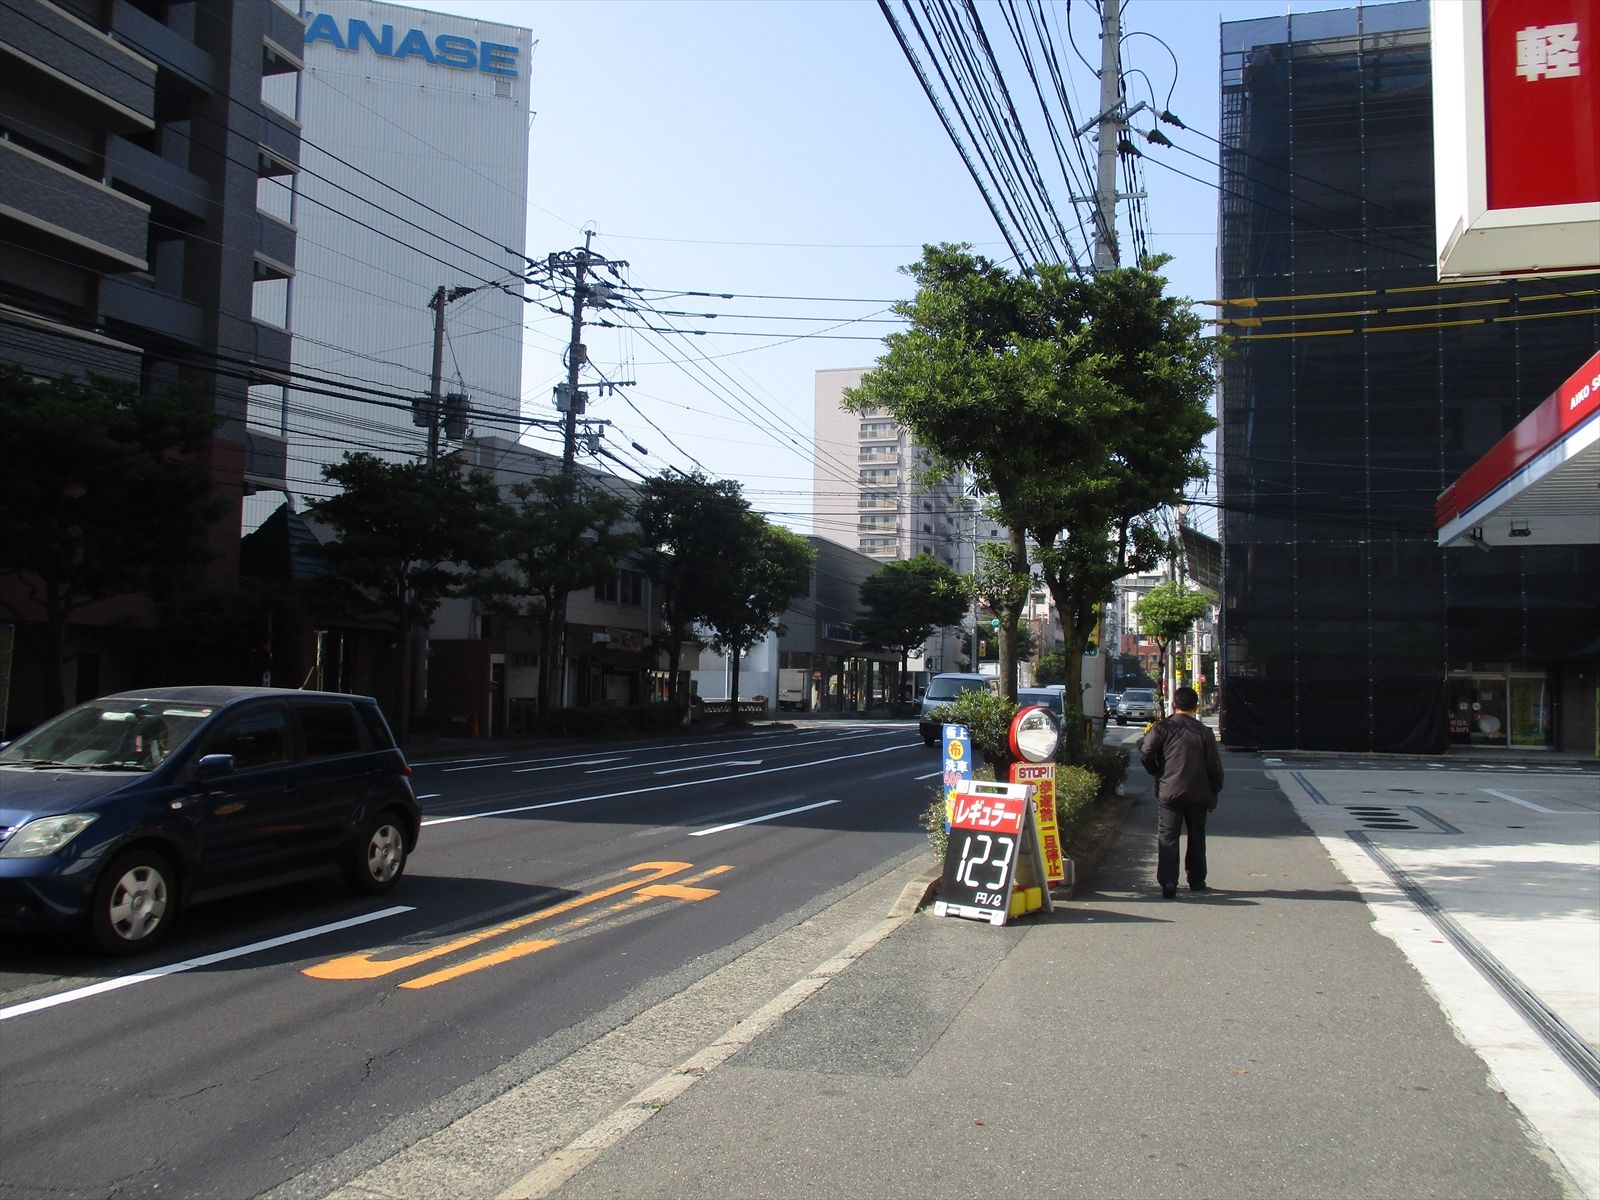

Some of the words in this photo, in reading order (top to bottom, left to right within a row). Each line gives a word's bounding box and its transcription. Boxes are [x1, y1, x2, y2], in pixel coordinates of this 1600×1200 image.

[302, 10, 519, 78] ANASE
[1516, 22, 1581, 82] 軽
[945, 758, 969, 773] 洗車
[955, 799, 1017, 827] レギュラー
[956, 834, 1014, 891] 123
